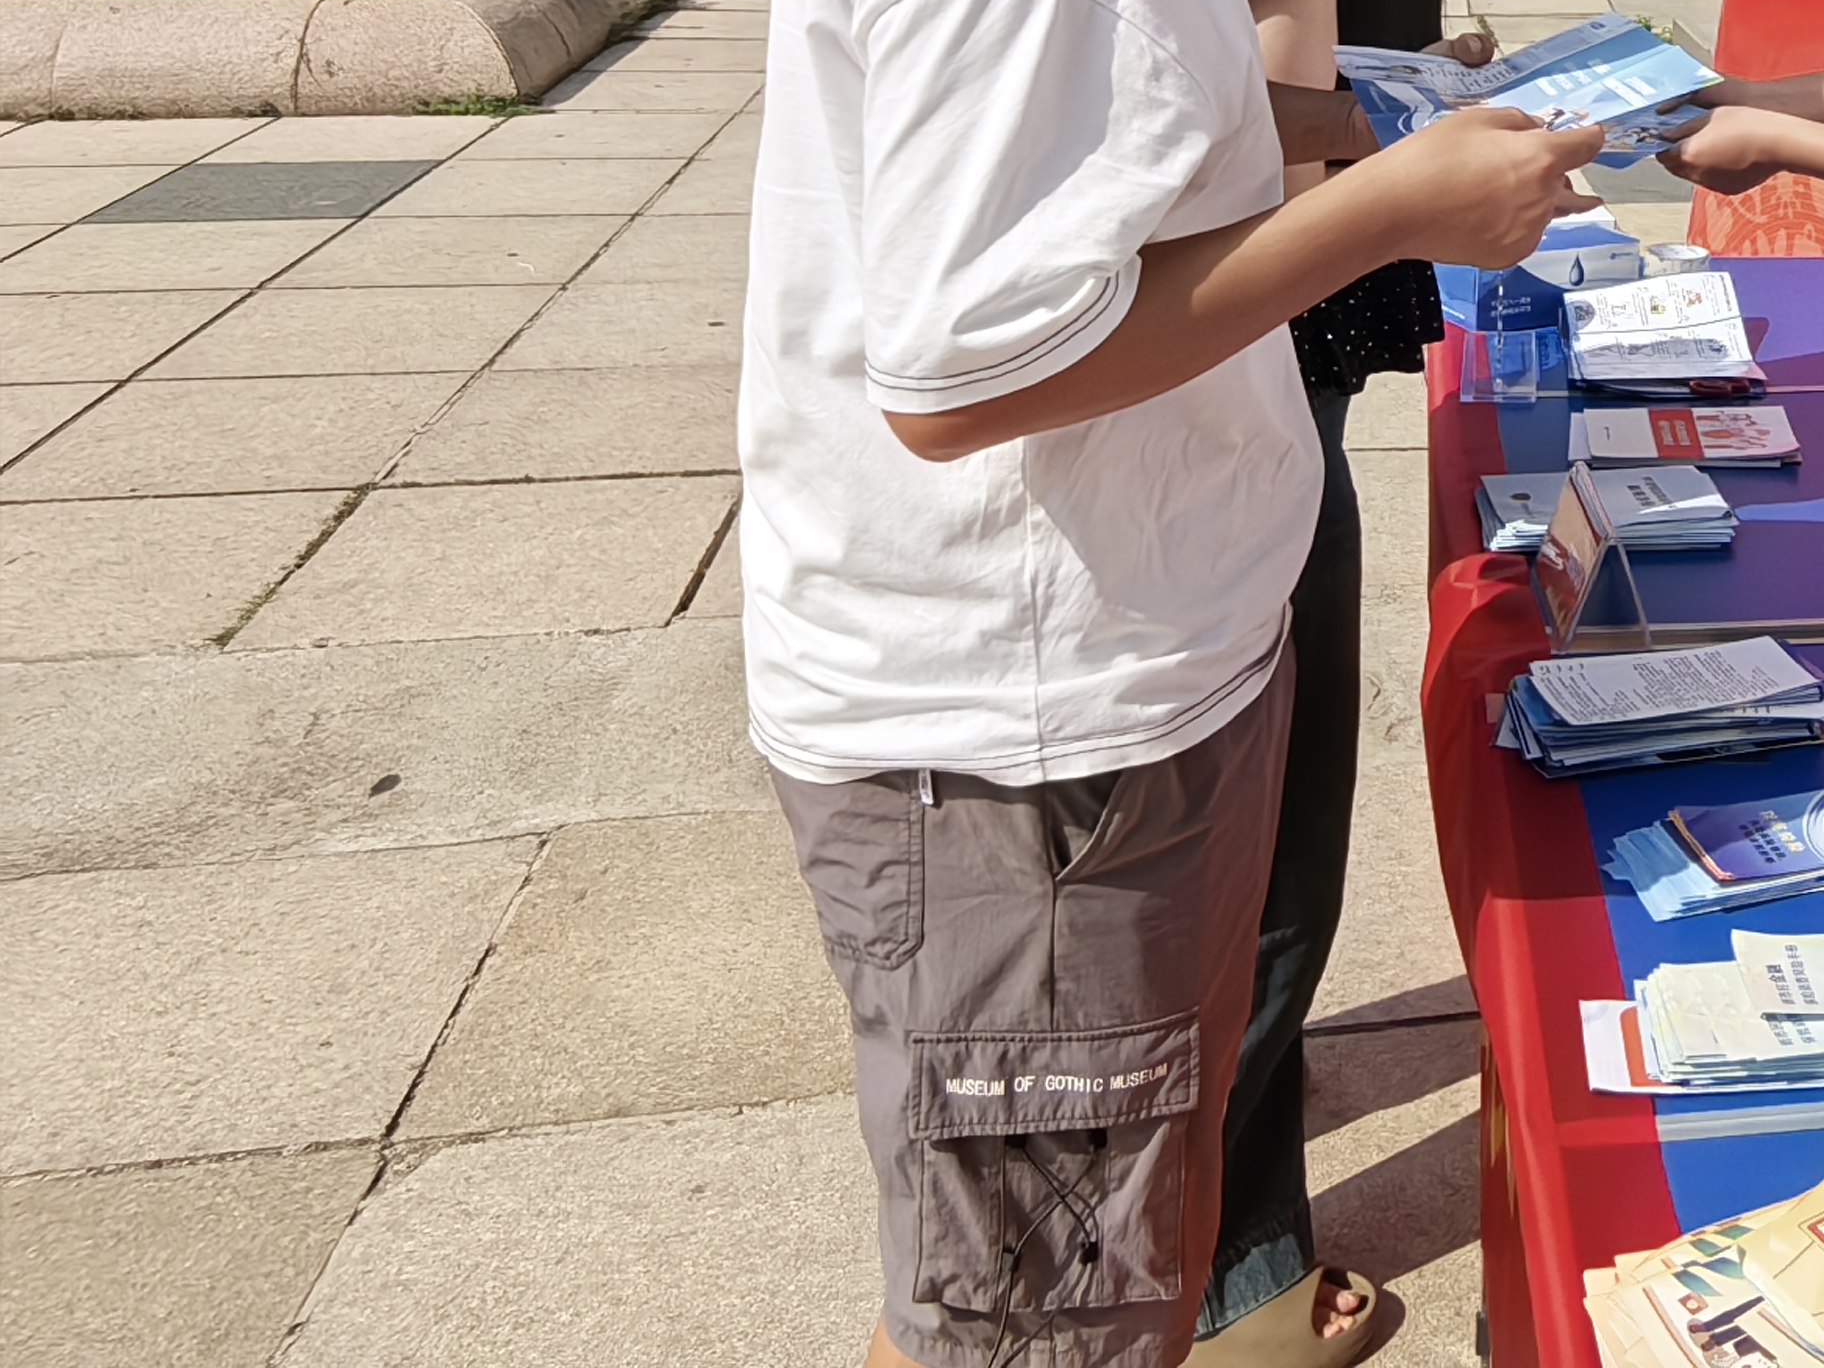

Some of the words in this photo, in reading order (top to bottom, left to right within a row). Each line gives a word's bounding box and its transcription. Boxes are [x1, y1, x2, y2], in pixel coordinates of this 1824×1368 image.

[946, 1078, 1005, 1096] MUSEUM
[1014, 1076, 1036, 1093] OF
[1045, 1075, 1104, 1093] GOTHIC
[1110, 1062, 1168, 1090] MUSEUM
